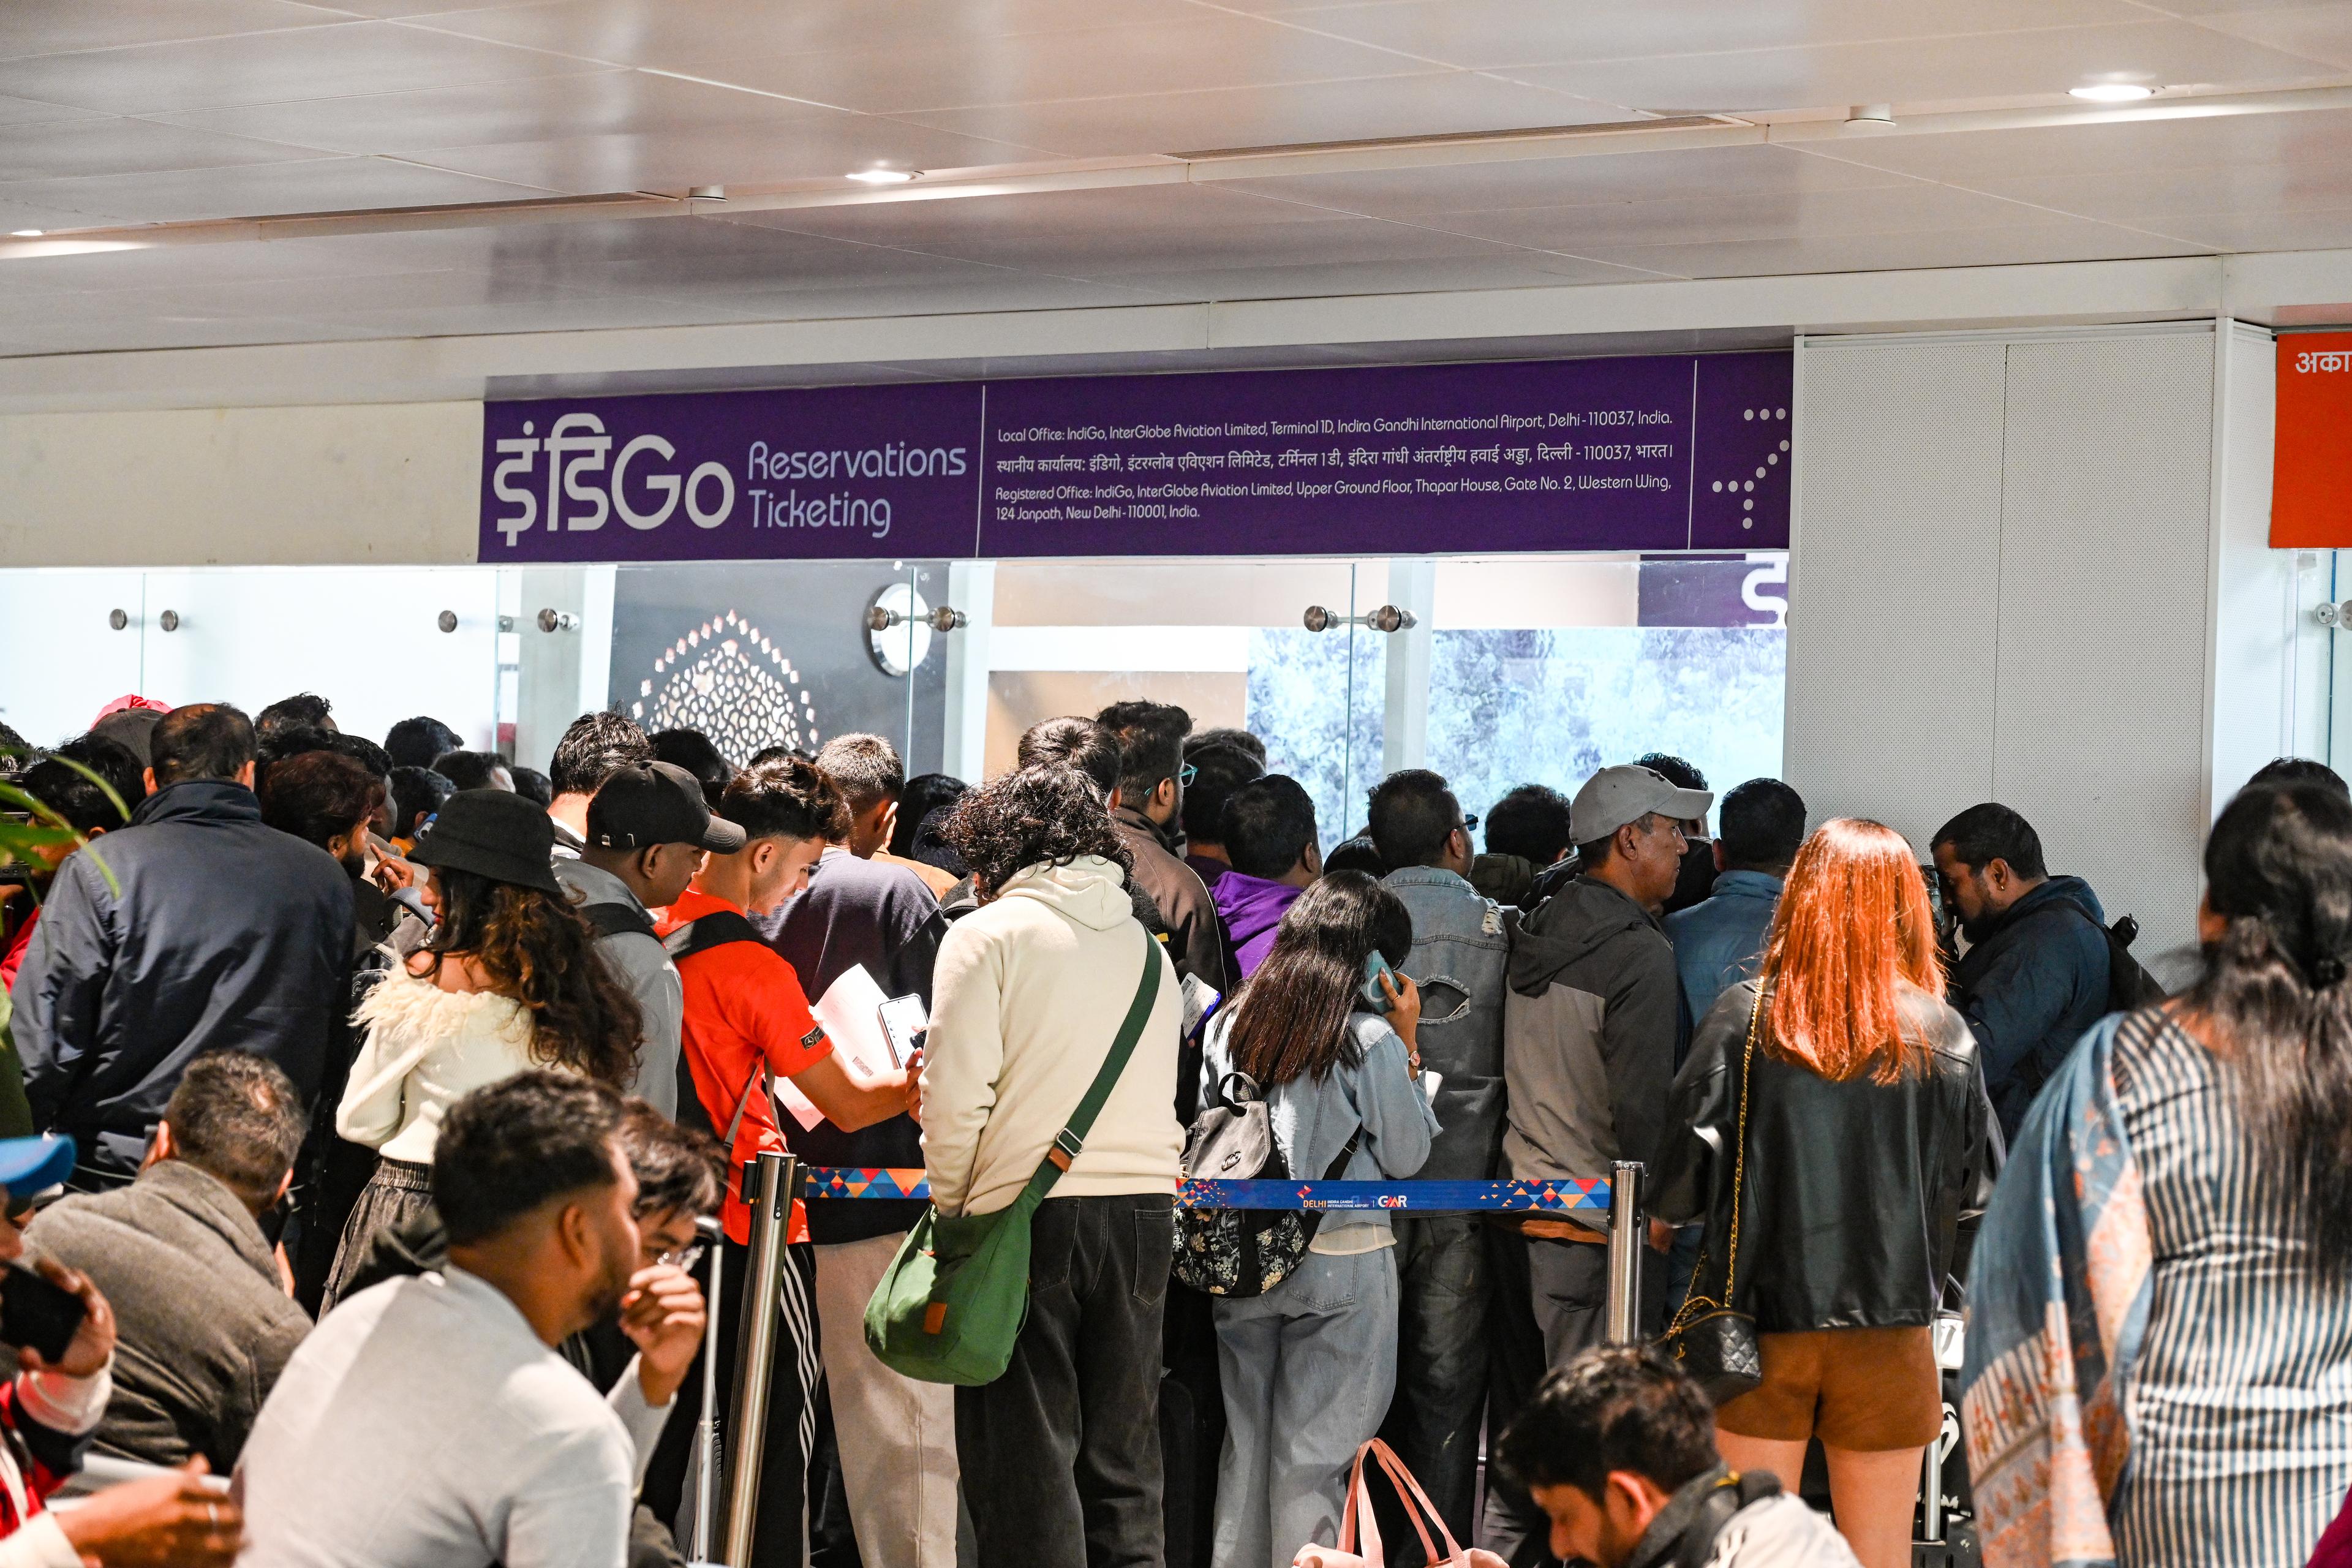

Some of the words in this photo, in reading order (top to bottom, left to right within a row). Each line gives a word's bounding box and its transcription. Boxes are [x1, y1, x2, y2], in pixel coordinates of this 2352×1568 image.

[998, 429, 1025, 442] Local
[1028, 428, 1065, 441] Office:
[1068, 426, 1107, 440] IndiGo,
[1110, 425, 1170, 439] InterGlobe
[1174, 424, 1221, 437] Aviation
[1225, 421, 1268, 436] Limited,
[1271, 421, 1319, 434] Terminal
[1321, 420, 1335, 434] 1D,
[1338, 420, 1370, 432] Indira
[1374, 418, 1419, 431] Gandhi
[1422, 415, 1498, 430] International
[1501, 415, 1545, 431] Airport,
[1638, 410, 1673, 424] India.
[748, 441, 966, 480] Reservations
[997, 455, 1035, 472] स्थानीय
[1090, 454, 1123, 472] इंडिगो,
[1178, 452, 1224, 471] एविएशन
[1228, 450, 1273, 469] लिमिटेड,
[1348, 448, 1379, 466] इंदिरा
[1382, 447, 1409, 464] गांधी
[1470, 444, 1500, 464] हवाई
[1504, 448, 1532, 465] अड्डा,
[1537, 442, 1572, 461] दिल्ली
[1585, 445, 1631, 461] 110037,
[996, 487, 1054, 503] Registered
[1057, 486, 1093, 499] Office:
[1095, 485, 1134, 499] IndiGo,
[1137, 484, 1198, 497] InterGlobe
[1201, 483, 1248, 496] Aviation
[1251, 482, 1293, 496] Limited,
[1297, 481, 1332, 498] Upper
[1335, 480, 1380, 494] Ground
[1383, 480, 1412, 494] Floor,
[1415, 479, 1458, 496] Thapar
[1461, 478, 1502, 492] House,
[1505, 477, 1537, 491] Gate
[1541, 477, 1560, 489] No.
[1564, 476, 1575, 491] 2,
[1579, 475, 1632, 489] Western
[1636, 474, 1672, 491] Wing,
[748, 489, 891, 538] Ticketing
[997, 507, 1015, 520] 124
[1017, 507, 1063, 522] Janpath,
[1066, 506, 1091, 519] New
[1170, 505, 1200, 518] India.
[1378, 1196, 1407, 1208] GMR
